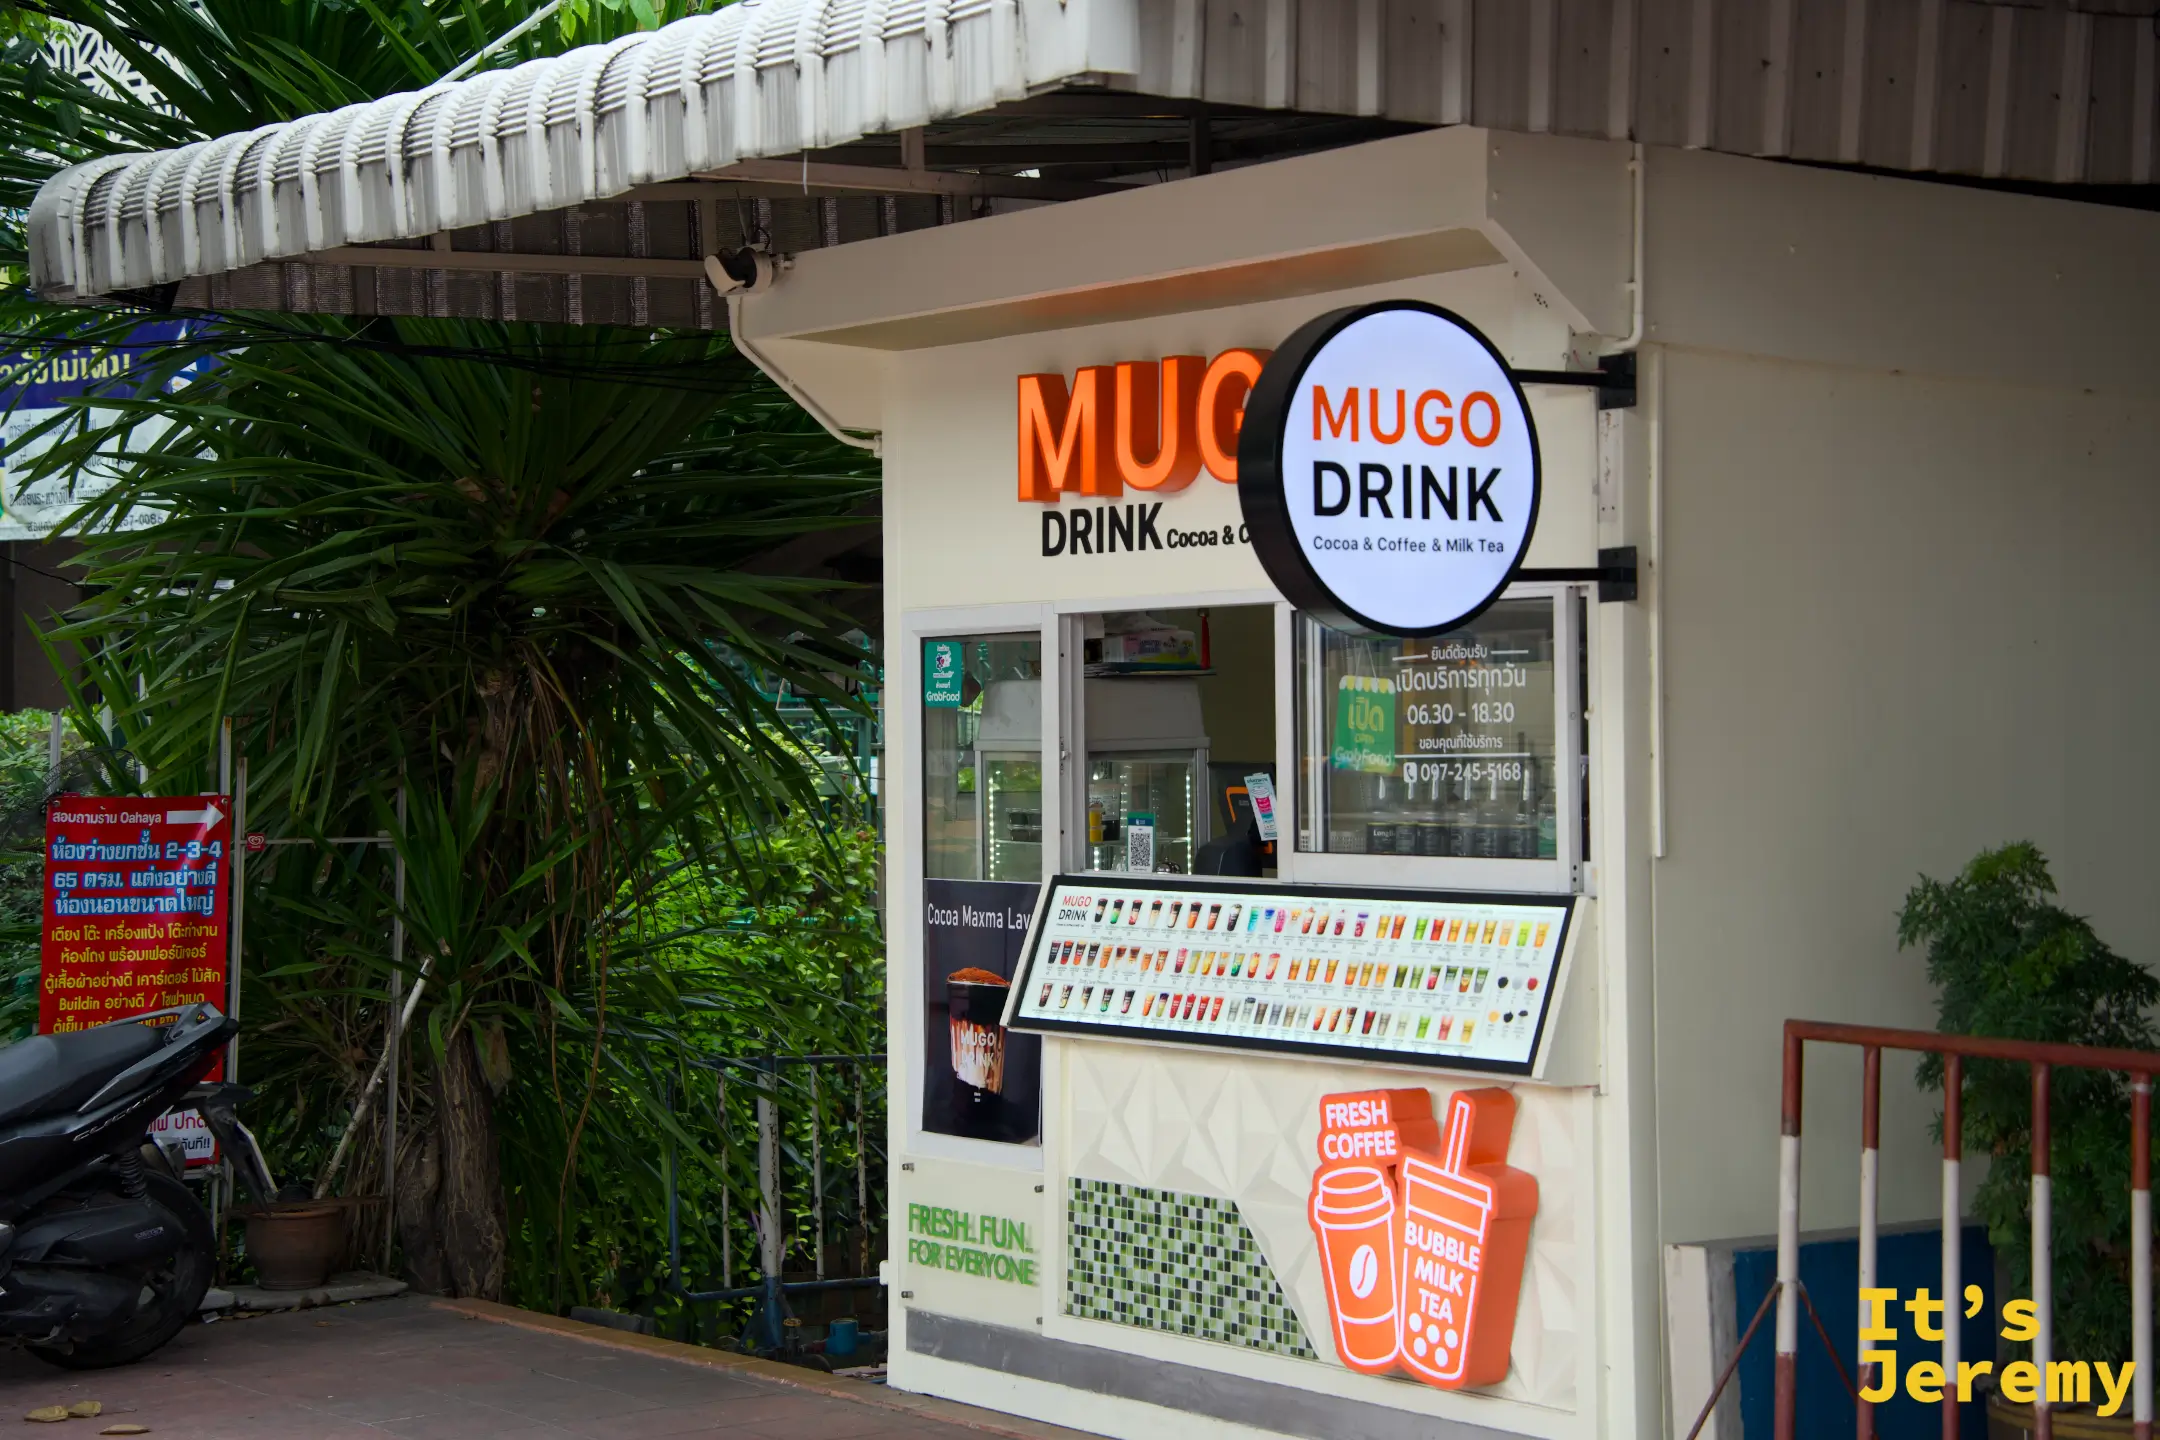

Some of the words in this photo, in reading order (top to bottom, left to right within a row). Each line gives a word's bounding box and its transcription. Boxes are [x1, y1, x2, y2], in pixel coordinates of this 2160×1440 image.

[1312, 385, 1501, 448] MUGO
[1313, 461, 1503, 522] DRINK
[1042, 502, 1163, 557] DRINK
[1167, 528, 1218, 549] Cocoa
[1222, 525, 1235, 545] &
[1313, 535, 1358, 550] Cocoa
[1363, 536, 1373, 551] &
[1377, 537, 1426, 552] Coffee
[1432, 539, 1441, 552] &
[1446, 539, 1474, 552] Milk
[1479, 539, 1504, 553] Tea
[1431, 644, 1488, 660] ยินดีต้อนรับ
[1396, 661, 1526, 695] เปิดบริการทุกวัน
[926, 690, 960, 702] GrabFood
[1347, 696, 1384, 732] เปิด
[1407, 703, 1453, 724] 06.30
[1472, 701, 1515, 723] 18.30
[1419, 728, 1504, 753] ขอบคุณที่ใช้บริการ
[1420, 762, 1521, 781] 097-245-5168
[52, 829, 161, 860] ห้องว่างยกชั้น
[166, 840, 222, 860] 2-3-4
[54, 872, 78, 888] 65
[55, 888, 214, 916] ห้องนอนขนาดใหญ่
[1058, 909, 1088, 921] DRINK
[1063, 896, 1092, 907] MUGO
[927, 903, 959, 926] Cocoa
[962, 905, 1003, 929] Maxma
[59, 996, 100, 1011] Buildin
[1326, 1100, 1389, 1128] FRESH
[1323, 1130, 1397, 1160] COFFEE
[1404, 1221, 1480, 1272] BUBBLE
[909, 1239, 941, 1269] FOR
[946, 1245, 1034, 1285] EVERYONE
[1414, 1257, 1464, 1297] MILK
[1418, 1288, 1453, 1324] TEA
